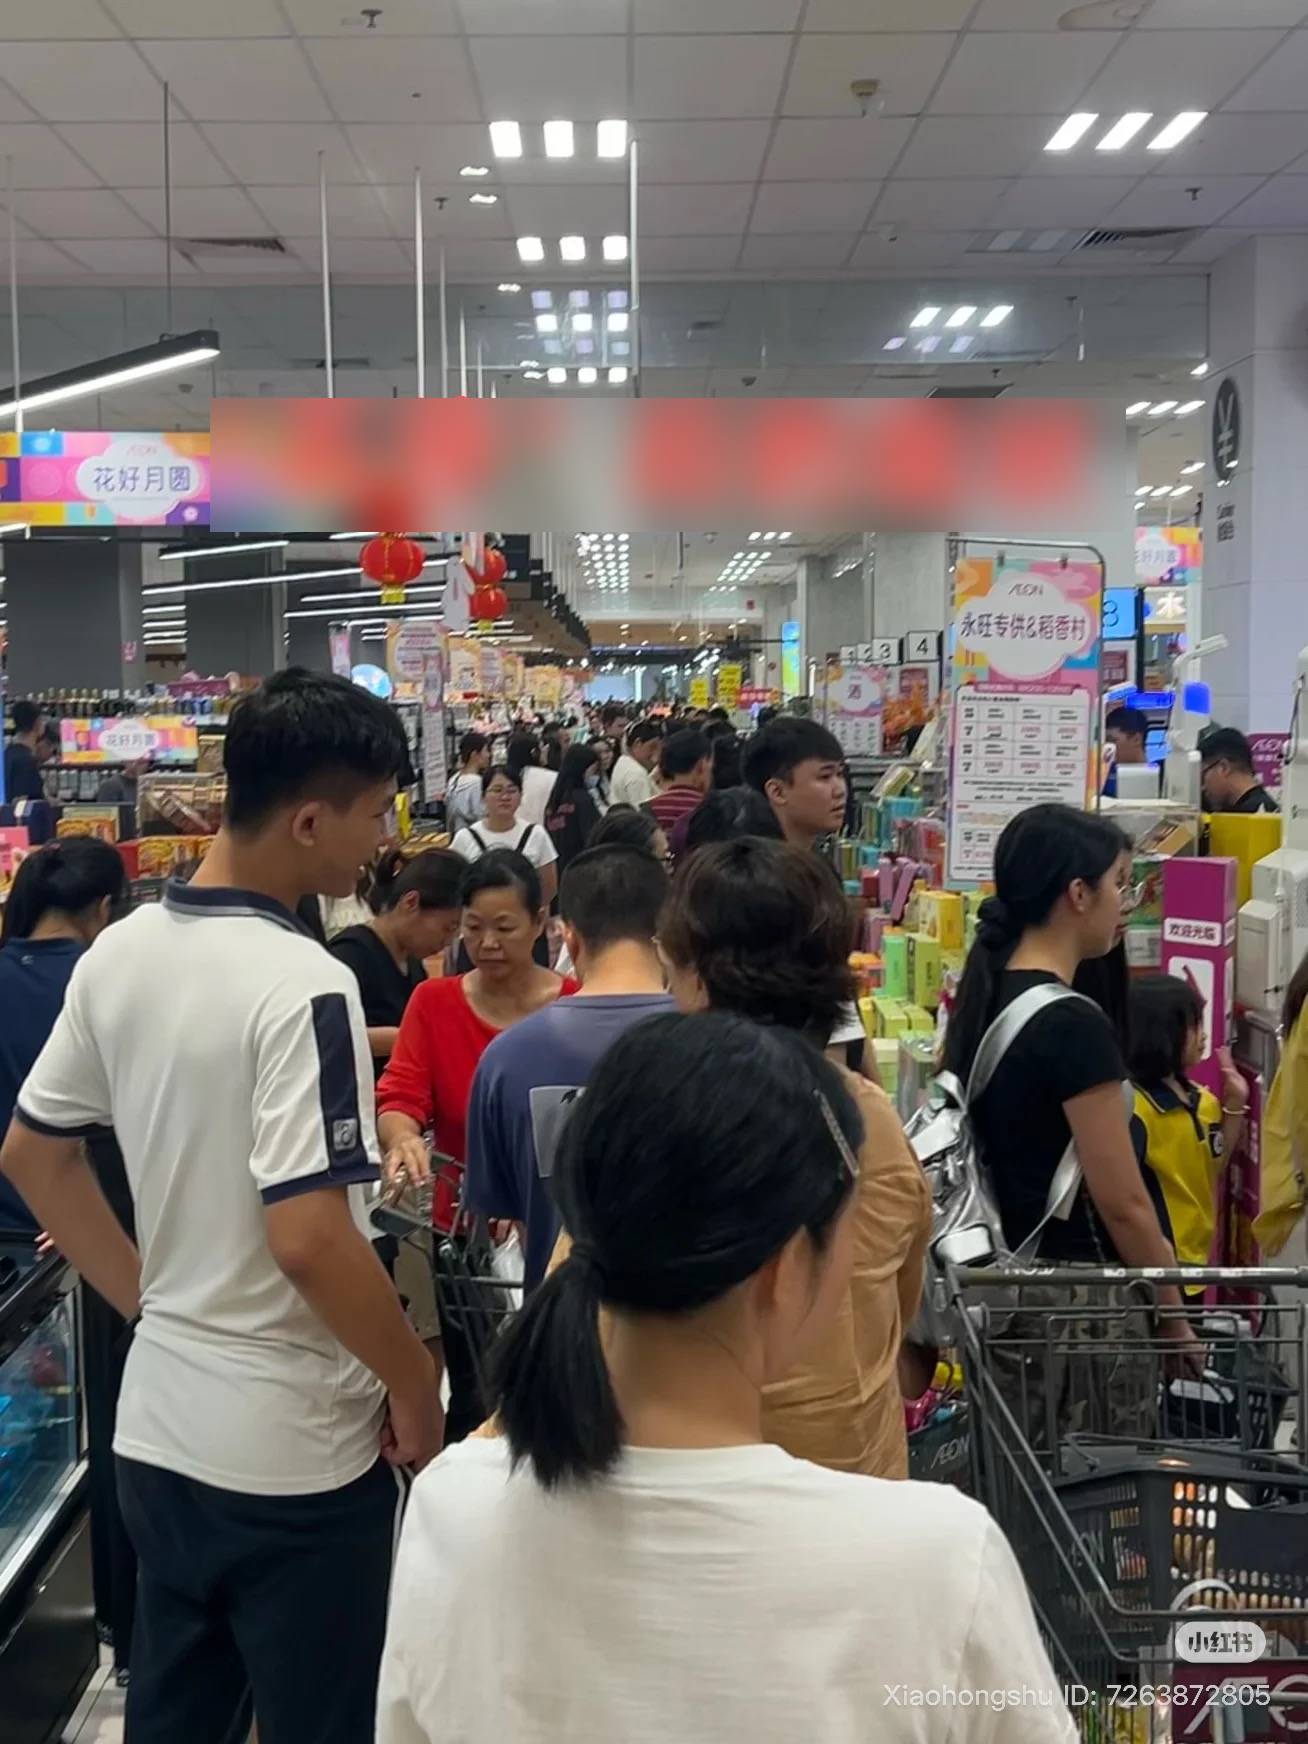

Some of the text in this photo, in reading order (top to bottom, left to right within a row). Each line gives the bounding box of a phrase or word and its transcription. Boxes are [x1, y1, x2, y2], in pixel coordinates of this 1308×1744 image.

[93, 465, 190, 492] 花好月圆
[960, 611, 1086, 641] 永旺专供&稻香村
[879, 643, 891, 660] 3
[915, 638, 929, 655] 4
